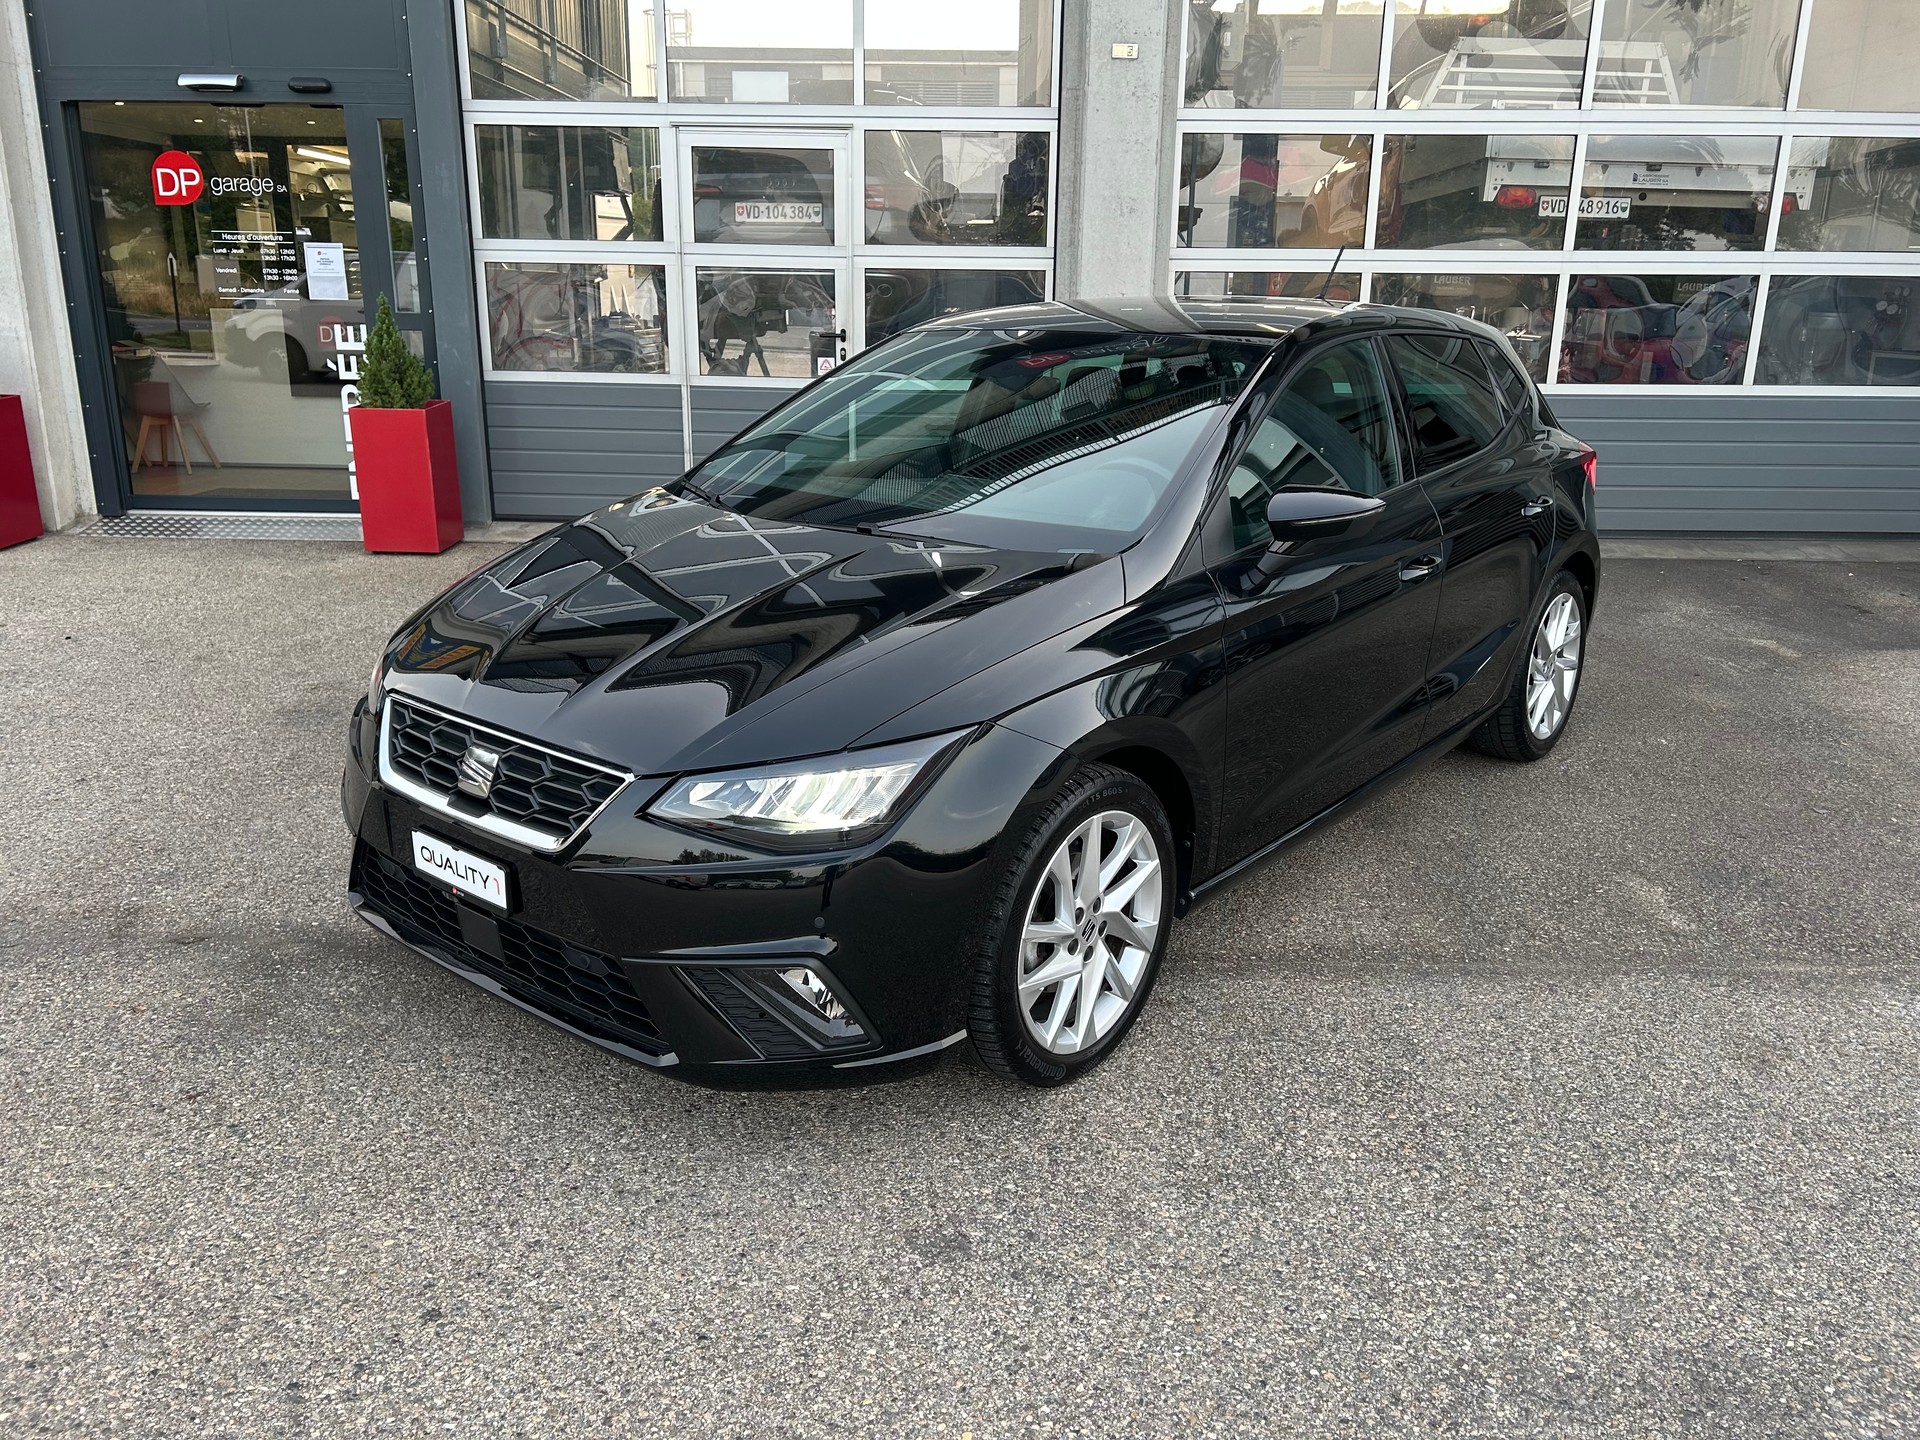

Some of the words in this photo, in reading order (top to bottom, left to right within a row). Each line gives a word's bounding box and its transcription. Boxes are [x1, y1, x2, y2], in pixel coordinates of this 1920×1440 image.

[156, 168, 200, 197] DP
[210, 177, 274, 197] garage
[276, 185, 288, 193] SA
[1578, 200, 1619, 214] 48916
[221, 233, 246, 241] Heures
[246, 233, 283, 242] d'ouverture
[1434, 275, 1471, 286] LAUBER
[420, 845, 490, 889] QUALITY
[493, 877, 500, 895] 1
[1018, 1045, 1067, 1081] Continental
